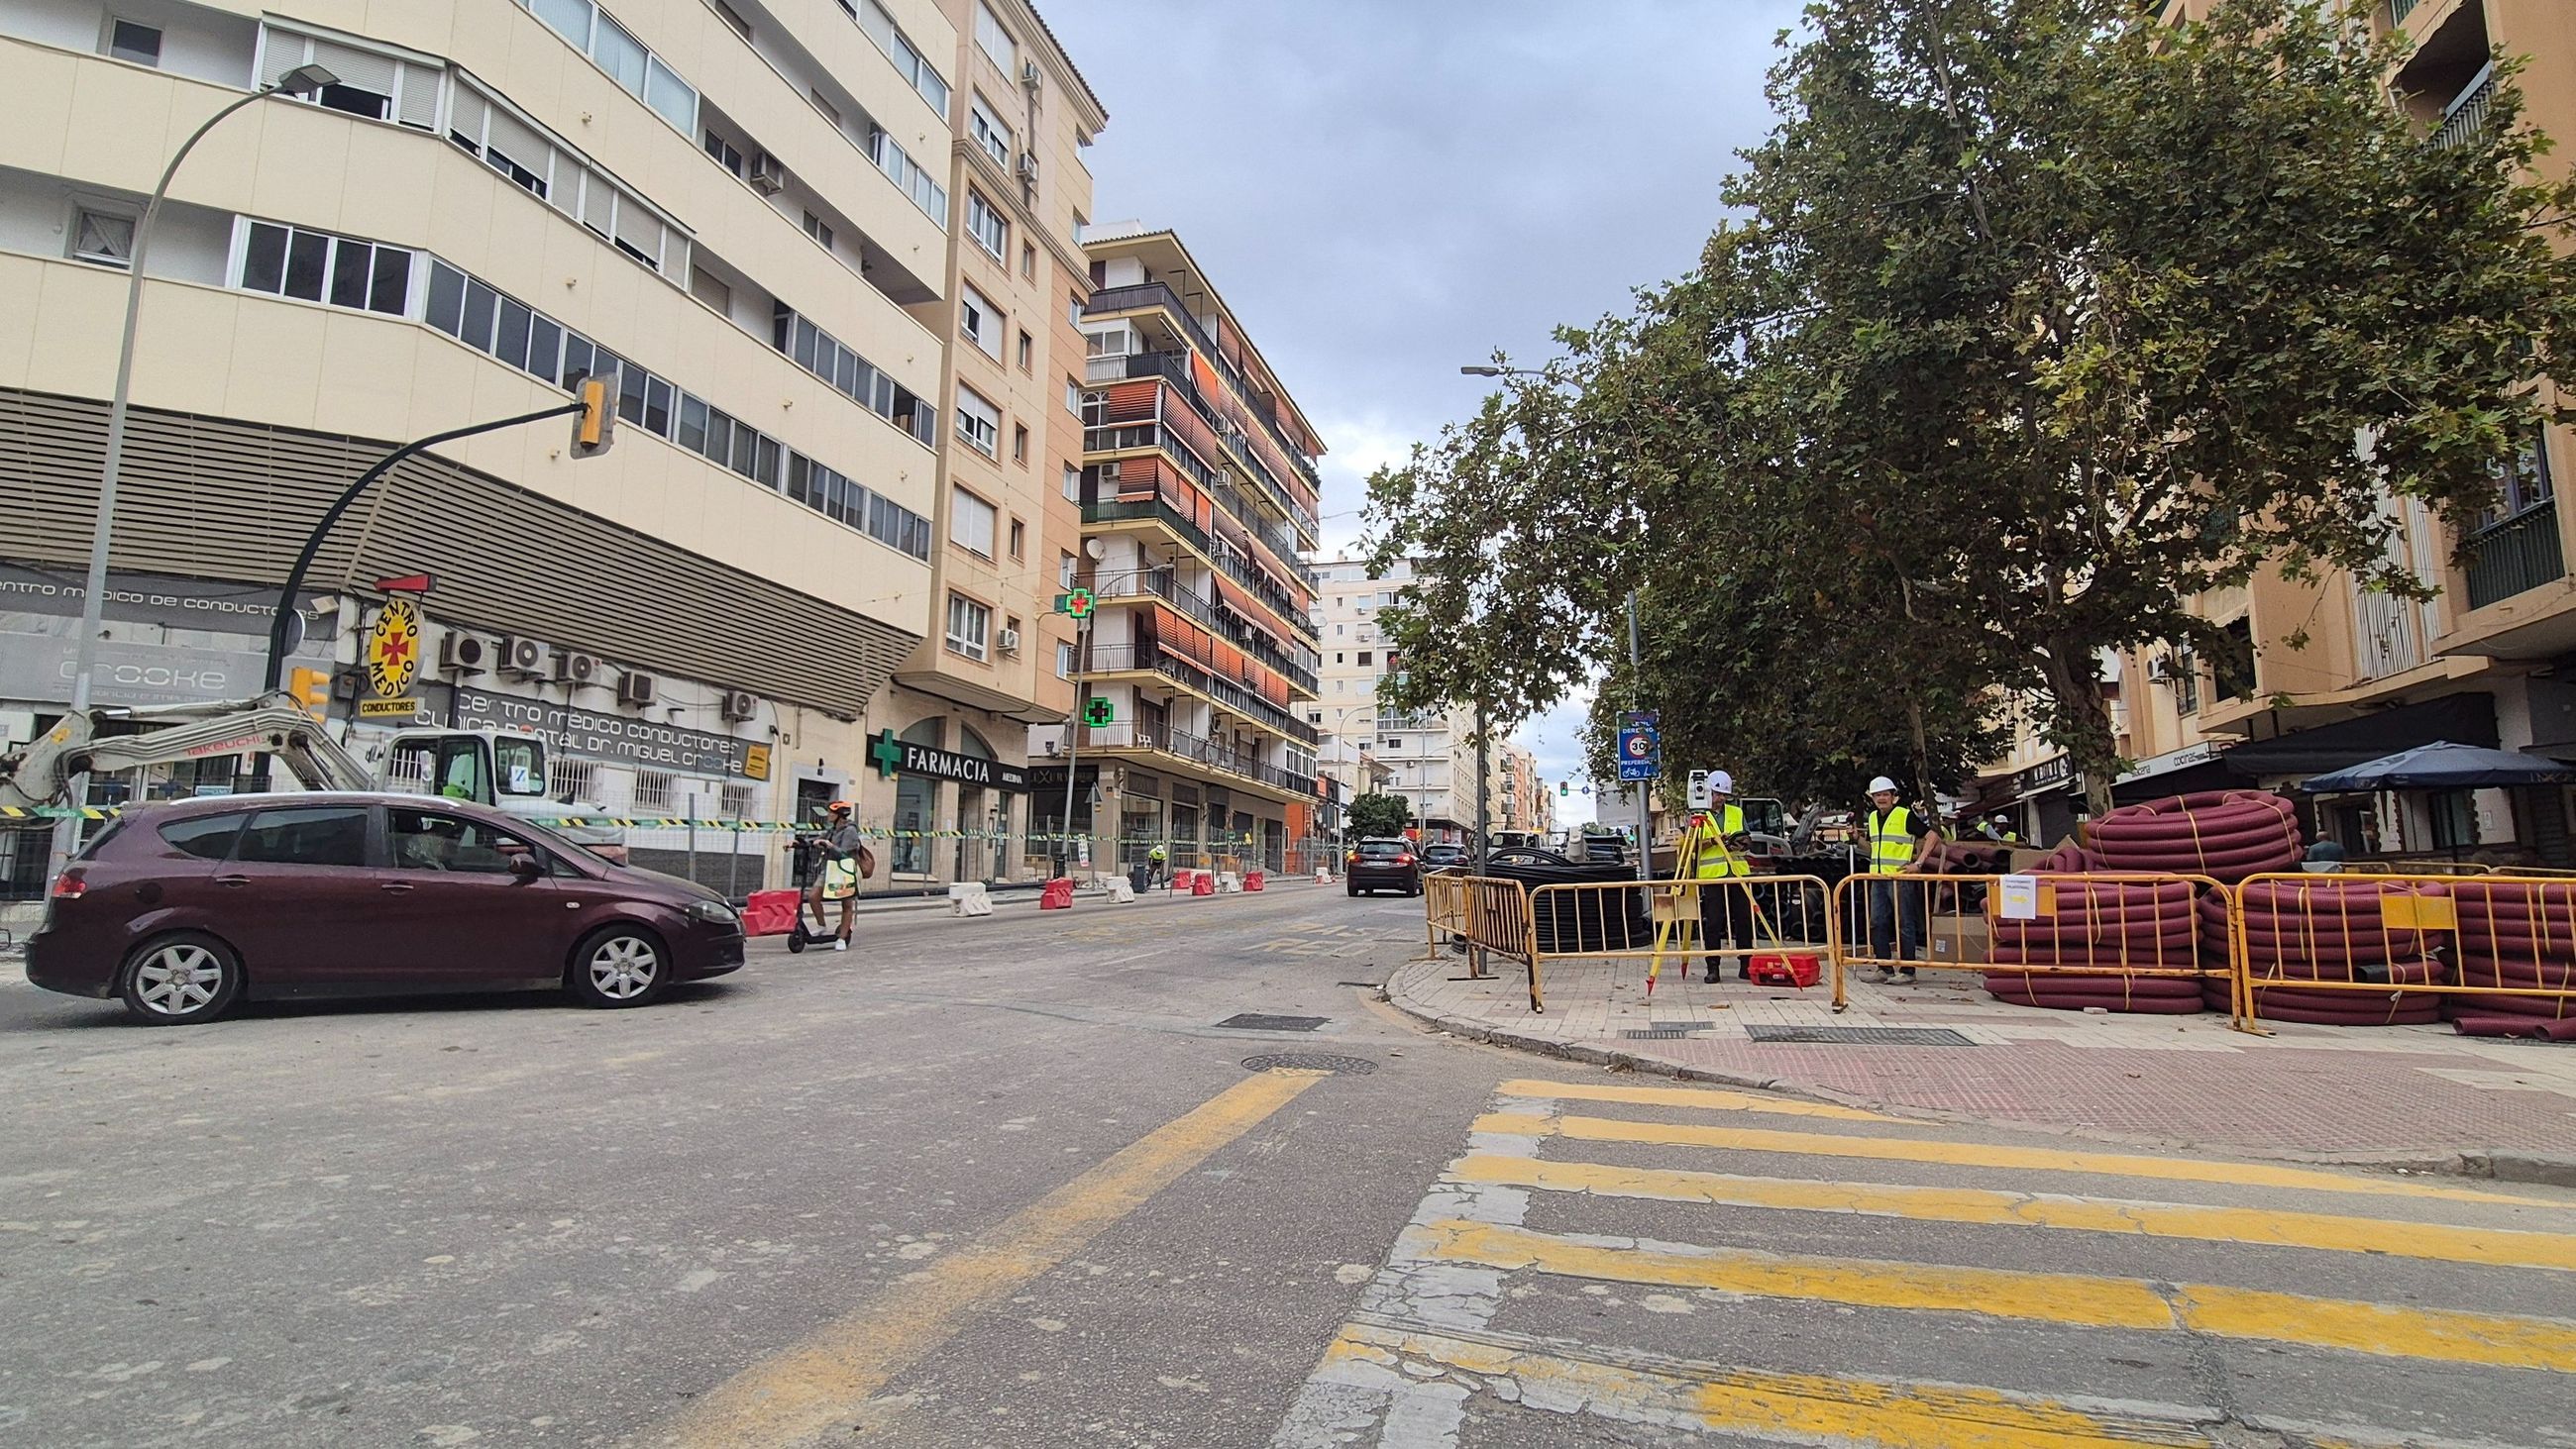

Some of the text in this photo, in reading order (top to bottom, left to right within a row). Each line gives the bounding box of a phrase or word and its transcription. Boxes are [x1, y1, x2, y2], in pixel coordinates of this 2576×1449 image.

[0, 580, 56, 595] ntro
[63, 586, 144, 603] mdico
[183, 598, 320, 621] conductoes
[376, 600, 418, 638] CENTRO
[372, 660, 414, 696] MEDICO
[362, 701, 415, 713] CONDUCTORES
[1631, 742, 1647, 751] 30
[907, 747, 990, 783] FARMACIA
